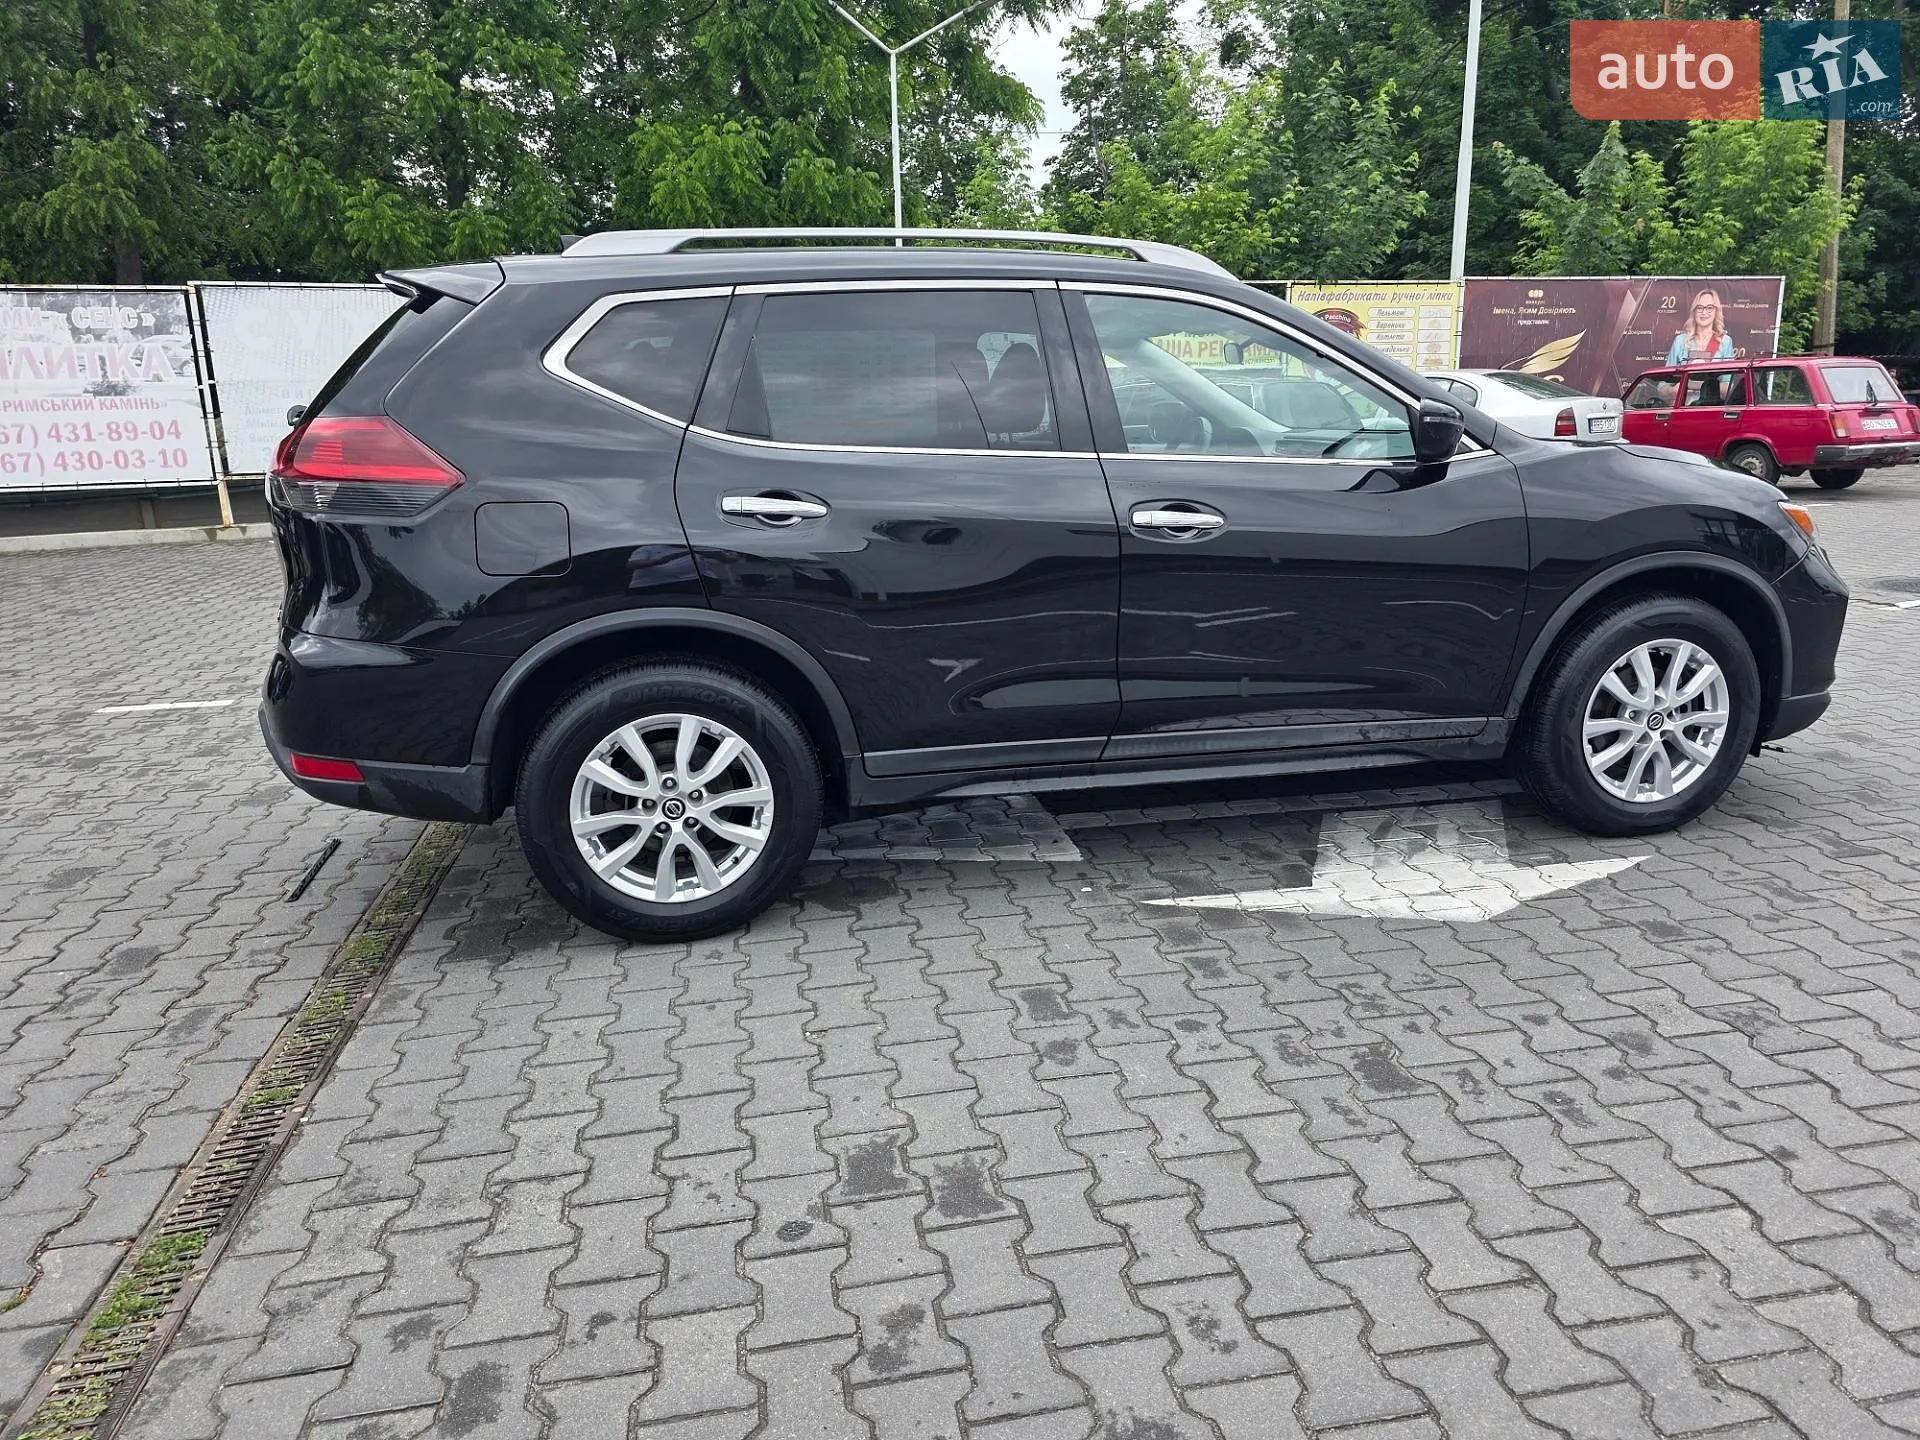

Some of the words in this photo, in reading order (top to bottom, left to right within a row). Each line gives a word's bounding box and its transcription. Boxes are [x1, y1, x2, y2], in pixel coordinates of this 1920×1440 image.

[1297, 288, 1387, 304] Напівфабрикати
[1390, 289, 1426, 304] ручної
[1426, 288, 1454, 302] ліпки
[1660, 295, 1676, 309] 20
[47, 419, 182, 443] 431-89-04
[53, 447, 188, 472] 430-03-10
